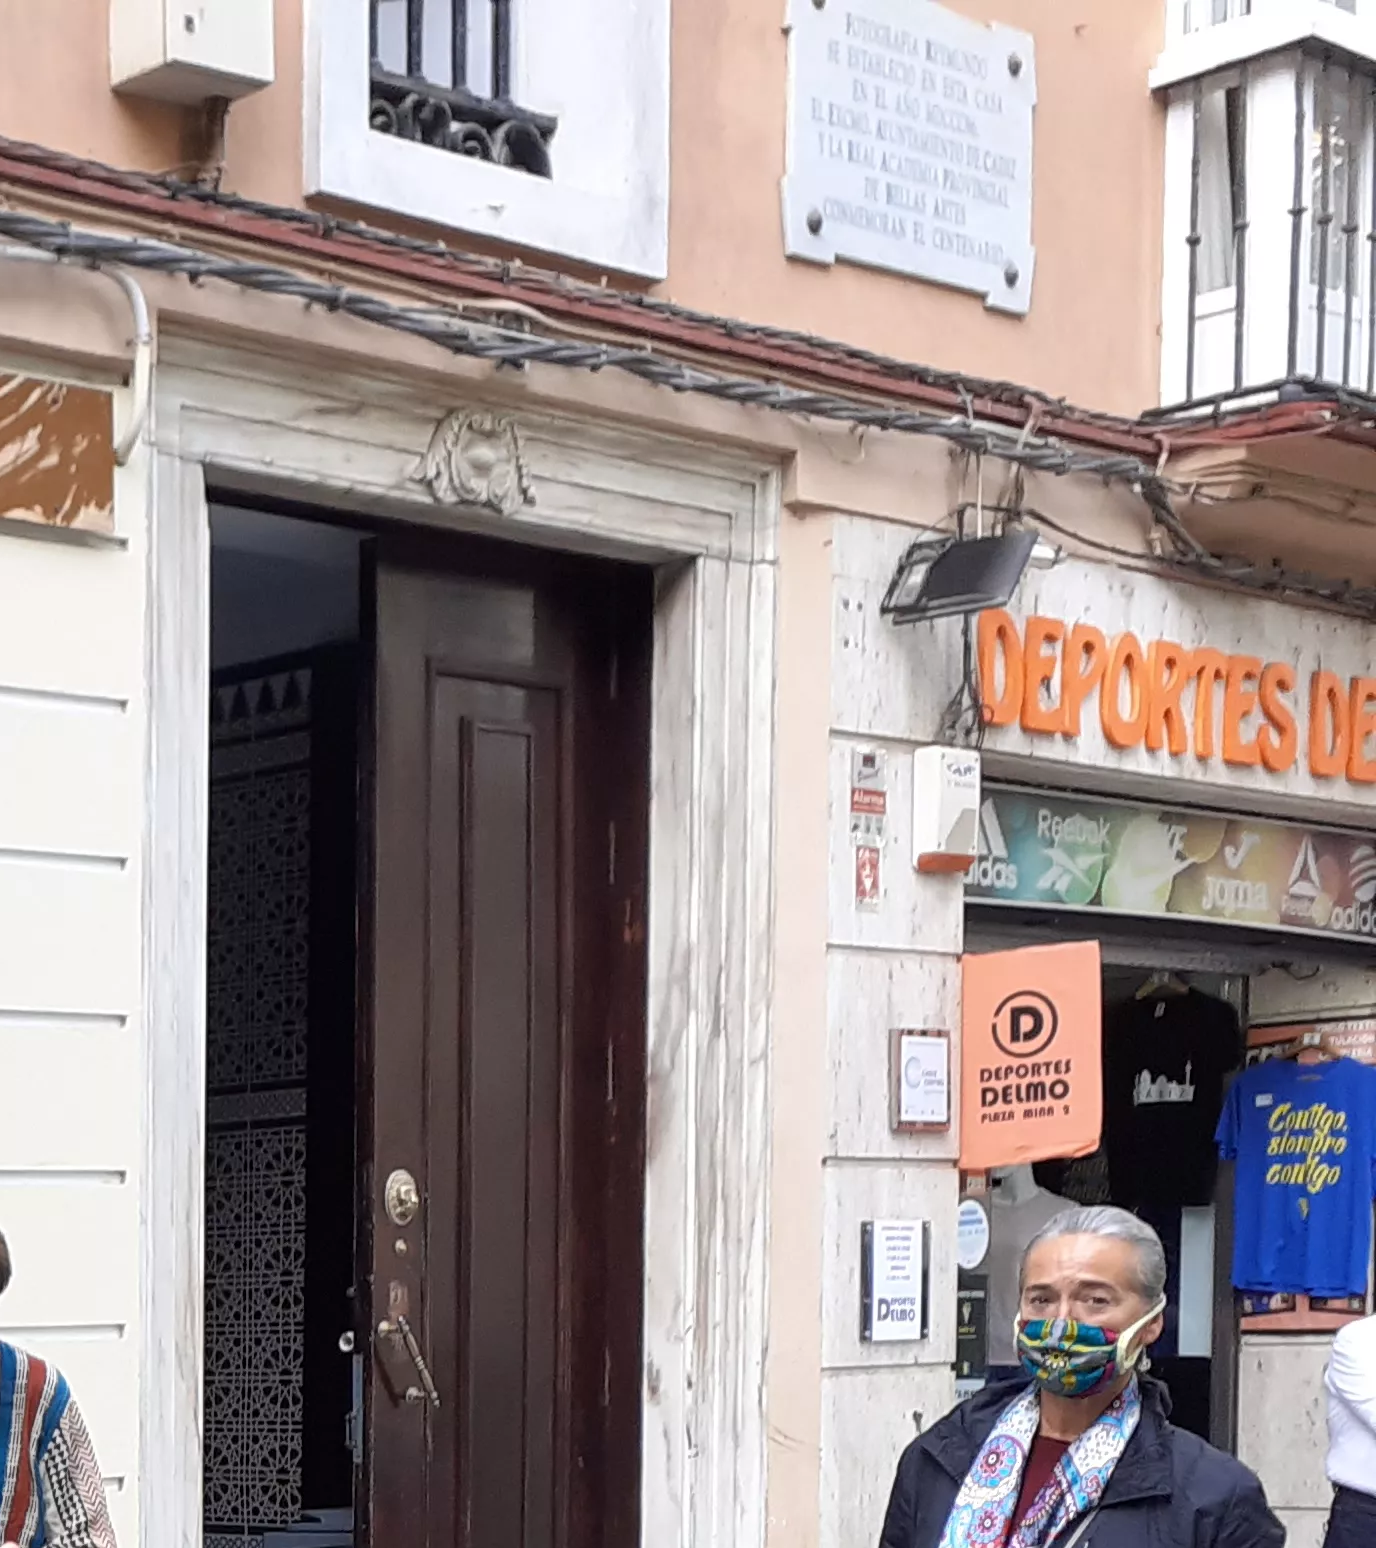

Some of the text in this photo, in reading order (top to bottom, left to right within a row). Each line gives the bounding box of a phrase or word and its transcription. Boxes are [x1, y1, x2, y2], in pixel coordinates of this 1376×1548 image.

[977, 606, 1298, 773] DEPORTES
[1037, 807, 1111, 845] Reebok
[962, 853, 1019, 890] idas
[979, 1058, 1072, 1083] DEPORTES
[980, 1078, 1071, 1108] DELMO
